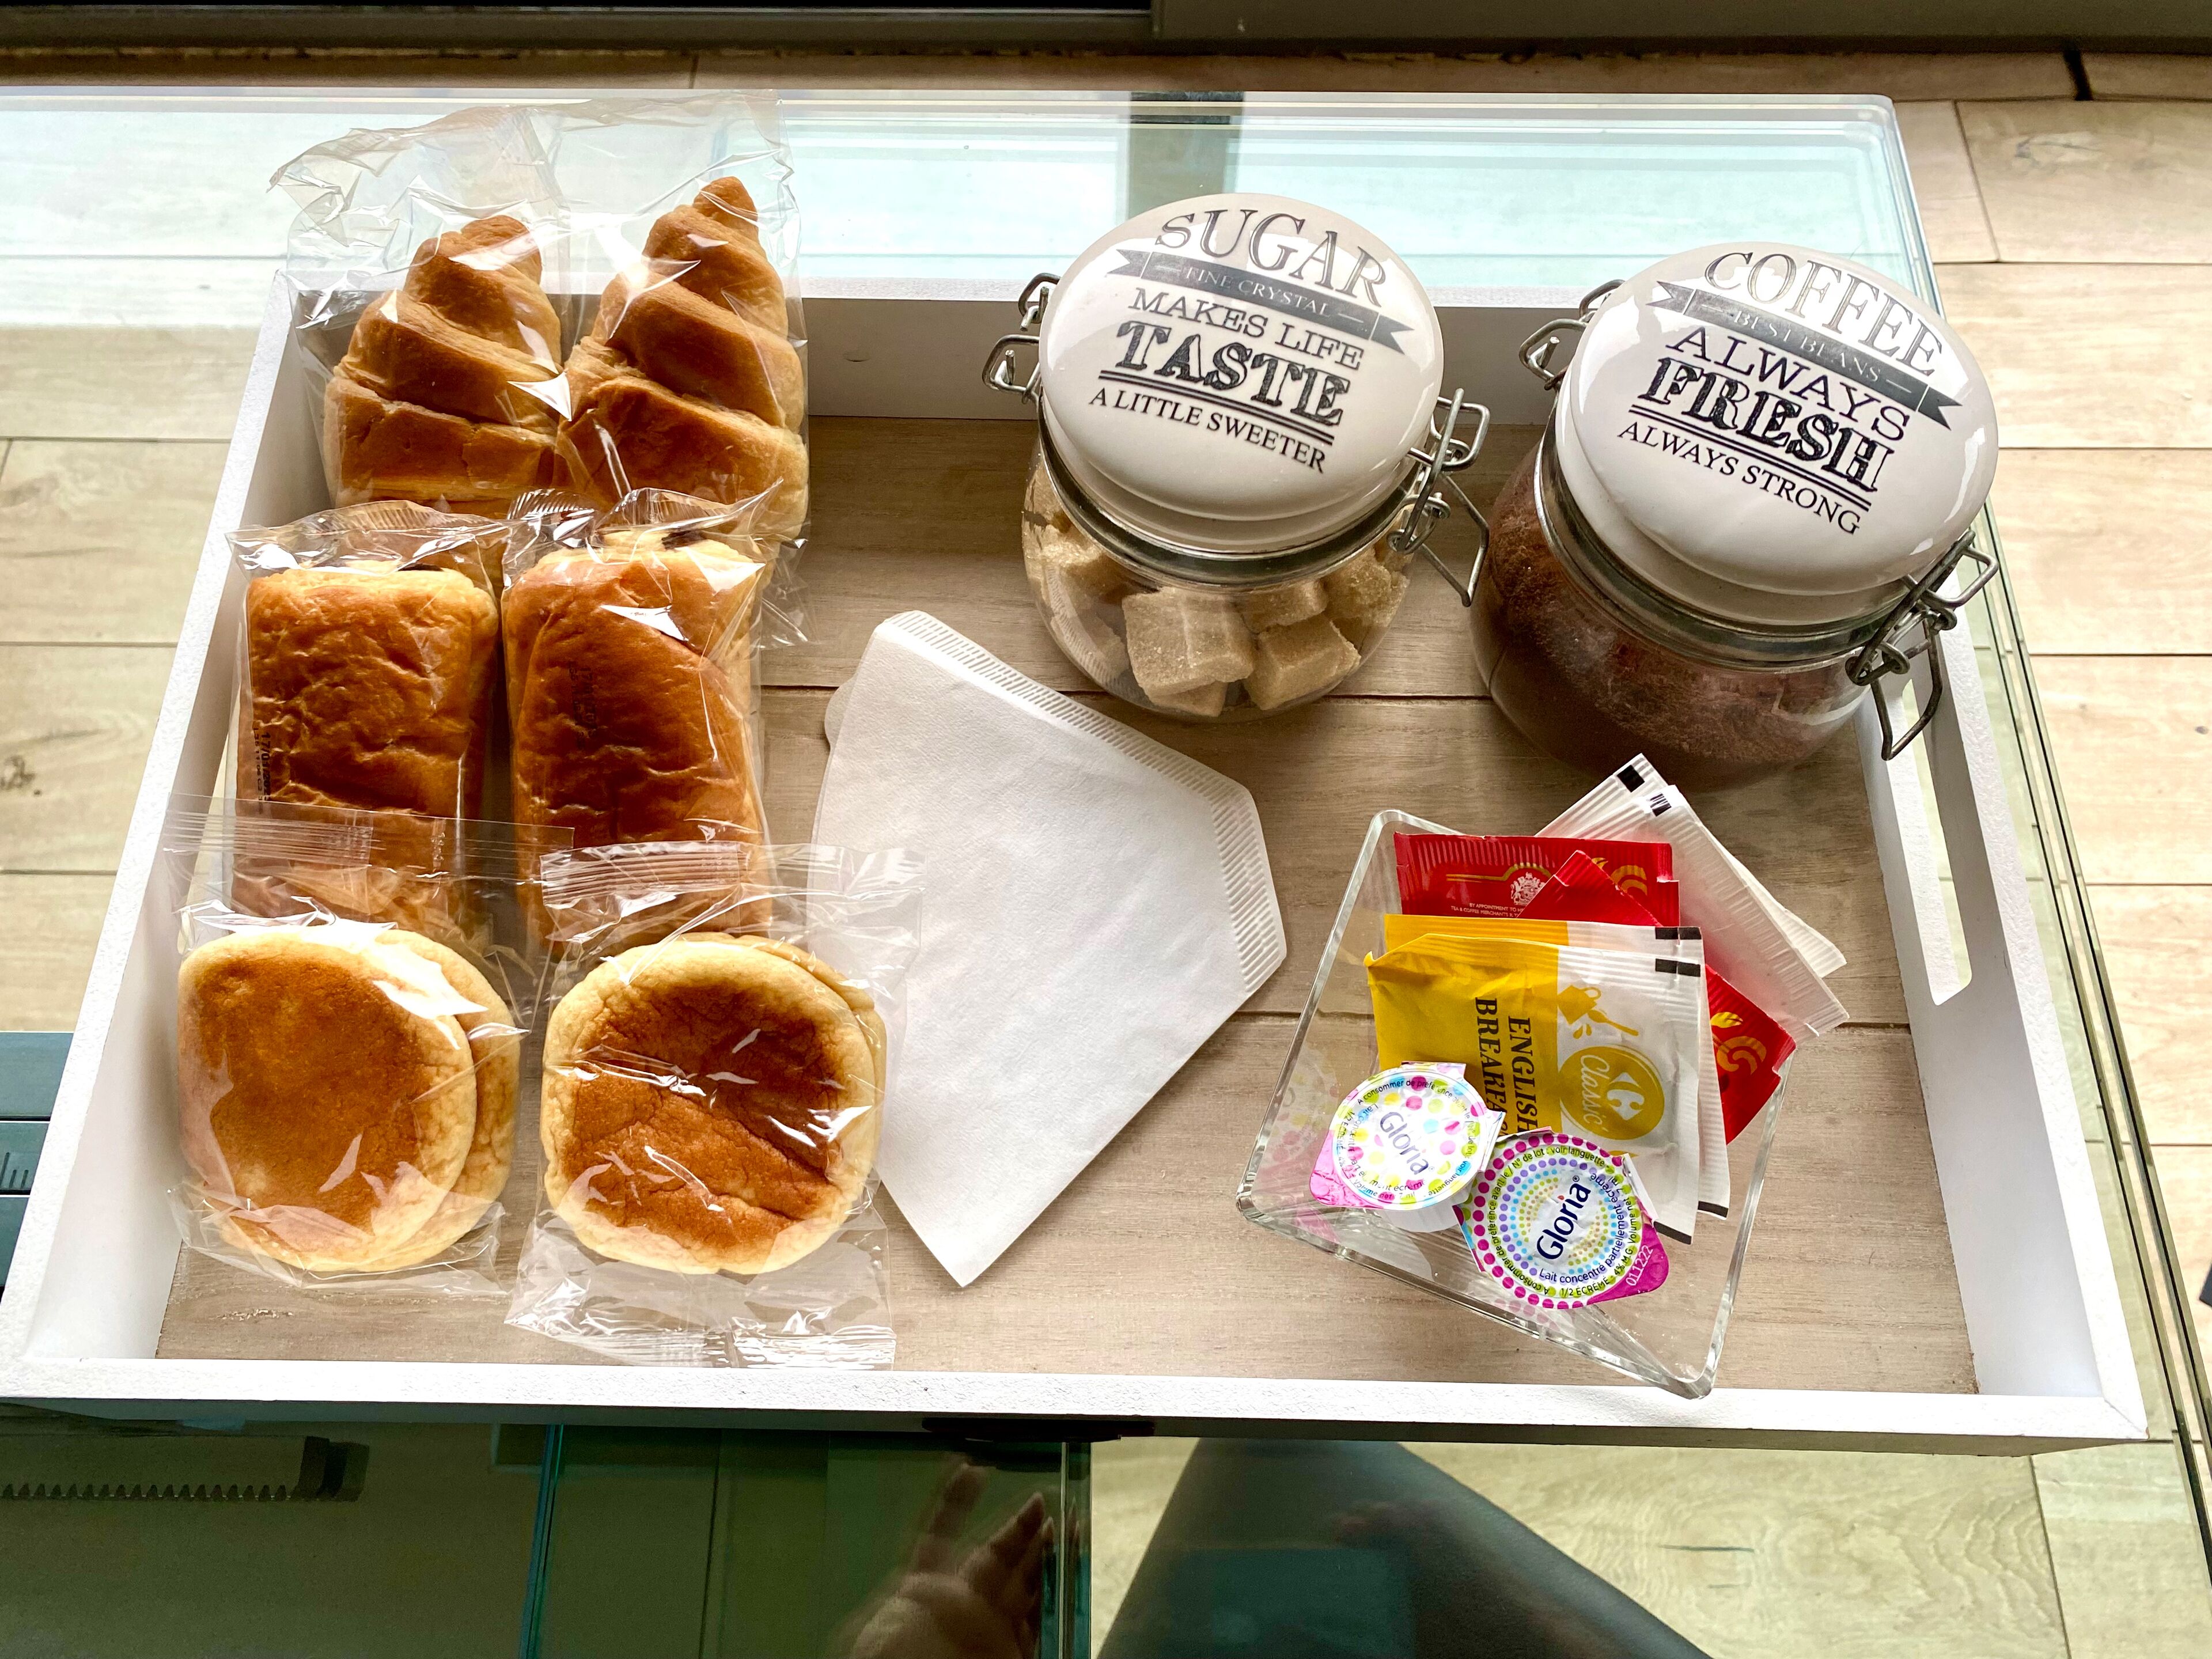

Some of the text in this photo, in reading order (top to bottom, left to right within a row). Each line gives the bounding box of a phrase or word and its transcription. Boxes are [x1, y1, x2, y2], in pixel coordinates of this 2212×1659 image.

[1154, 209, 1386, 308] SUGAR
[1185, 266, 1331, 317] FINE CRYSTAL
[1128, 287, 1366, 371] MAKES LIFE
[1705, 252, 1942, 377] COFFEE
[1116, 319, 1352, 427] TASTE
[1665, 327, 1910, 442] ALWAYS
[1089, 388, 1326, 475] A LITTLE SWEETER
[1638, 357, 1896, 494] FRESH
[1617, 422, 1862, 536] ALWAYS STRONG
[1475, 997, 1508, 1136] BREAKFA
[1508, 1015, 1538, 1134] ENGLISH
[1363, 1080, 1404, 1100] consommer
[1580, 1054, 1610, 1126] Classic
[1380, 1111, 1429, 1176] Gloria
[1522, 1153, 1533, 1162] de
[1533, 1148, 1545, 1158] lot
[1551, 1146, 1568, 1154] voir
[1568, 1146, 1605, 1167] languette
[1429, 1173, 1460, 1196] languette
[1457, 1161, 1468, 1173] voir
[1491, 1179, 1506, 1200] avant
[1623, 1197, 1633, 1211] net
[1487, 1201, 1501, 1245] préférence
[1536, 1181, 1592, 1260] Gloria
[1539, 1173, 1626, 1283] Lait concentré partiellement écrémé
[1627, 1213, 1638, 1244] Volume
[1495, 1245, 1506, 1256] de
[1613, 1263, 1626, 1275] 4%
[1625, 1244, 1654, 1286] 011222
[1502, 1256, 1542, 1291] consommer
[1560, 1287, 1574, 1297] 1/2
